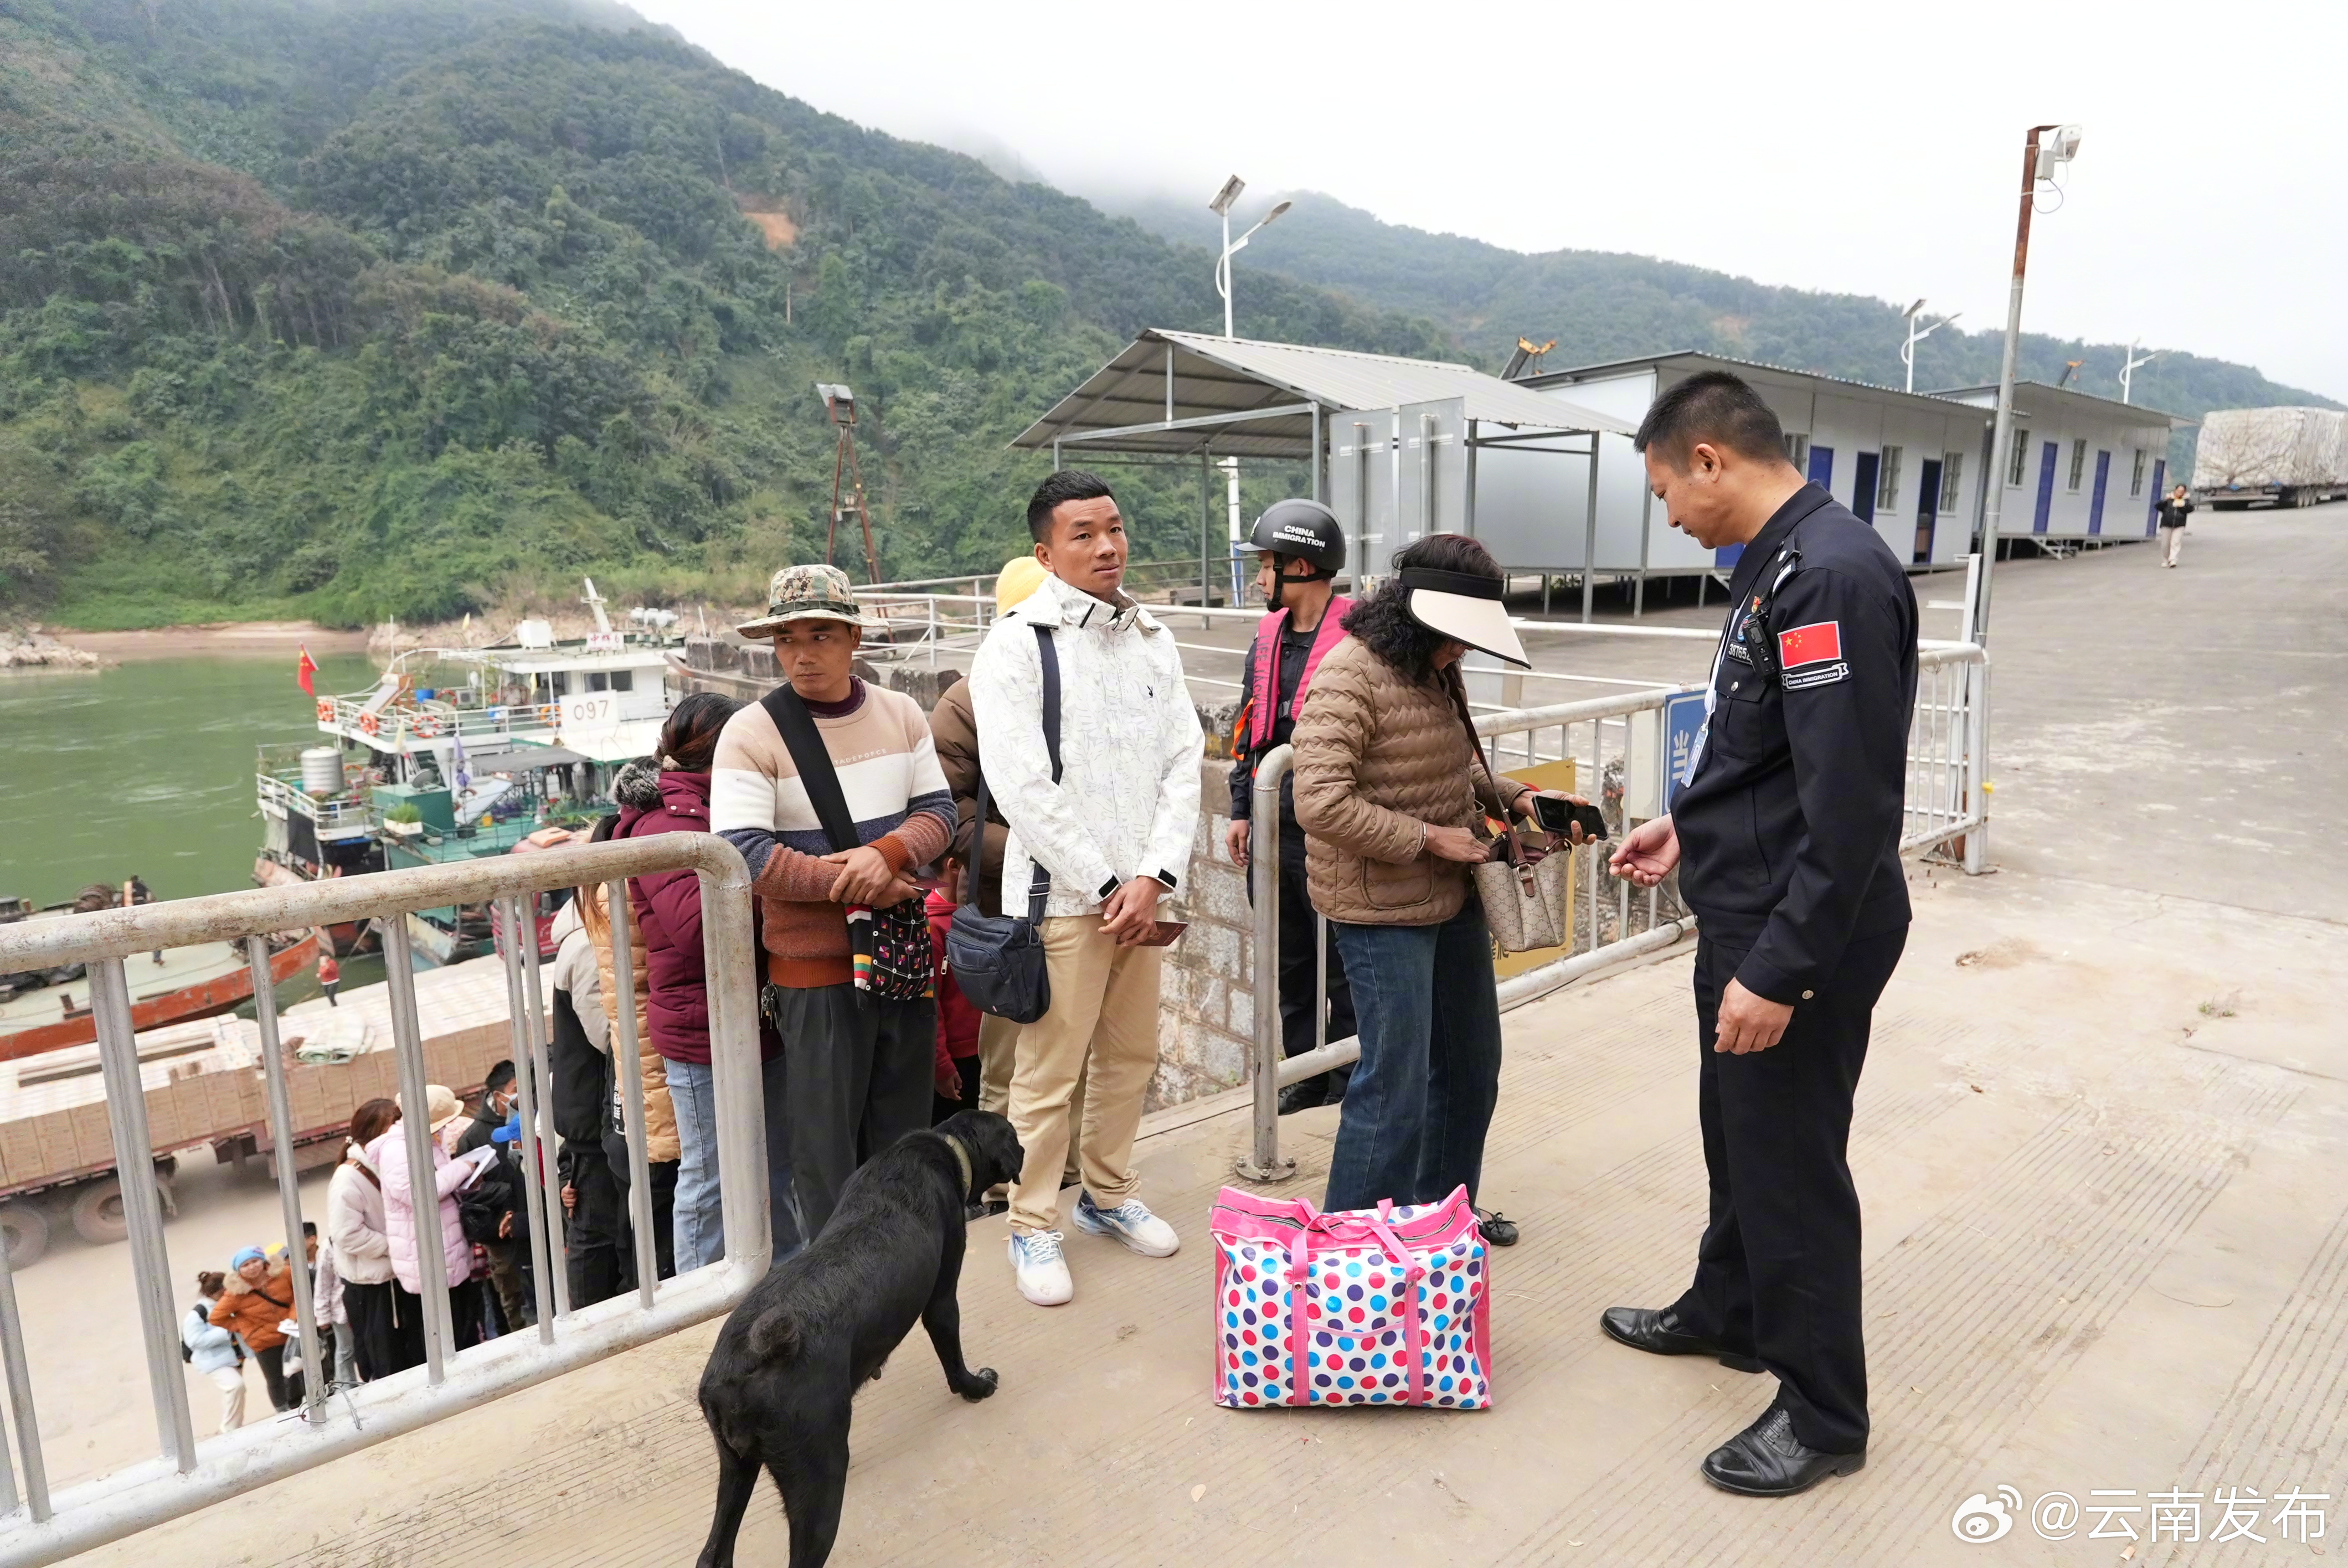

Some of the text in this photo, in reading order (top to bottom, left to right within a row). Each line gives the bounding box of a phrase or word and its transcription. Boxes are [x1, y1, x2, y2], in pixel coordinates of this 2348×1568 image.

[1284, 525, 1315, 538] CHINA
[1273, 532, 1325, 548] IMMIGRATION
[1252, 635, 1270, 720] LIFE JACKET
[1803, 672, 1838, 683] IMMIGRATION
[574, 700, 608, 720] 097
